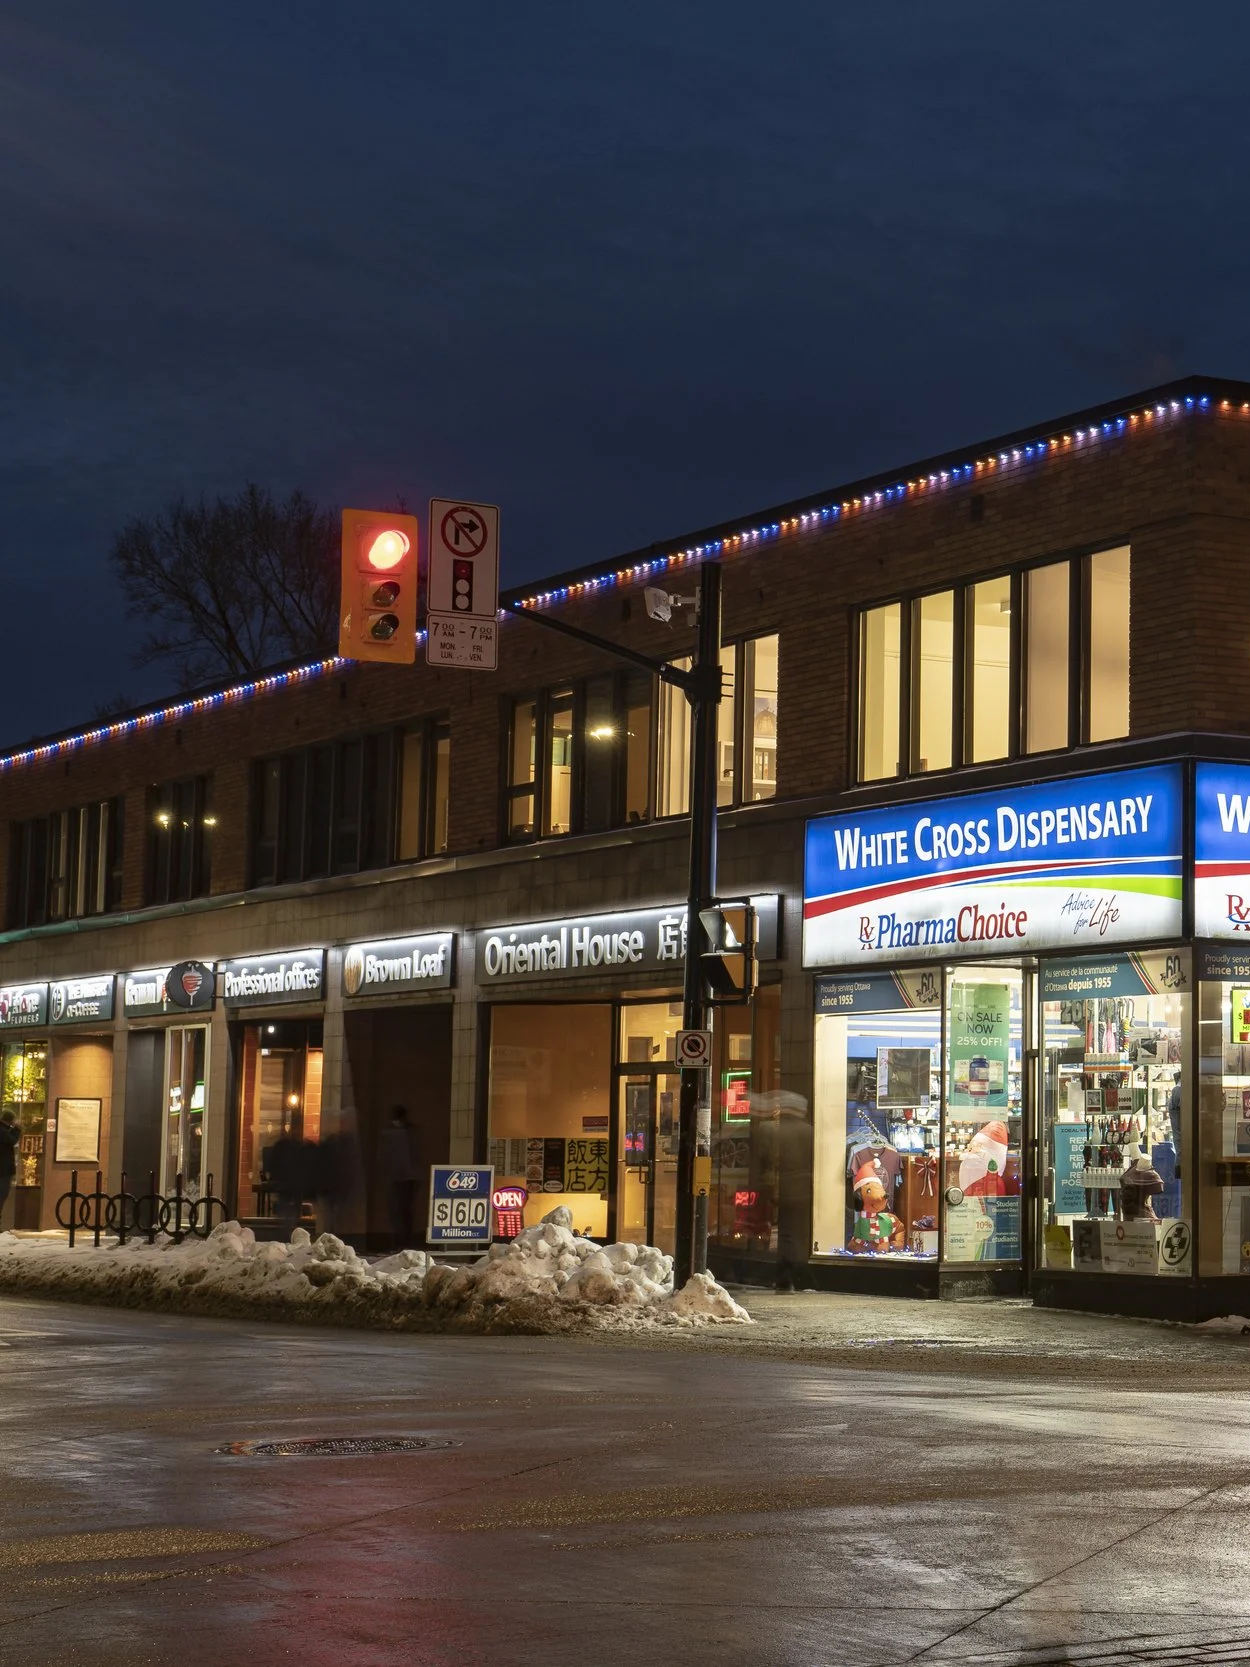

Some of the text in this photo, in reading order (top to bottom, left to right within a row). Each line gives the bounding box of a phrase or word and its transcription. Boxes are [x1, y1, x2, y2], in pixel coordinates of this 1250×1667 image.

[432, 622, 440, 636] 7
[470, 626, 477, 640] 7
[834, 795, 1153, 871] WHITE CROSS DISPENSARY
[1061, 892, 1095, 916] Advice
[1074, 895, 1121, 937] for Life
[875, 902, 1028, 950] PharmaChoice
[484, 926, 644, 977] Oriental House
[365, 944, 448, 985] Brown Loaf
[1204, 954, 1231, 964] Proudly
[1044, 964, 1118, 978] Au service de la communauté
[1165, 955, 1180, 988] 60
[1207, 965, 1232, 975] since
[224, 962, 320, 998] Professional offices
[1044, 977, 1112, 992] d'Ottawa depuis 1955
[820, 982, 871, 994] Proudly serving Ottawa
[921, 972, 934, 1003] 60
[821, 994, 854, 1006] since 1955
[11, 1014, 40, 1024] FLOWERS
[957, 1012, 1003, 1023] ON SALE
[1238, 1012, 1243, 1020] $
[966, 1024, 994, 1034] NOW
[956, 1036, 1003, 1046] 25% OFF!
[493, 1192, 523, 1207] OPEN
[976, 1221, 992, 1229] 10%
[442, 1228, 472, 1237] Million
